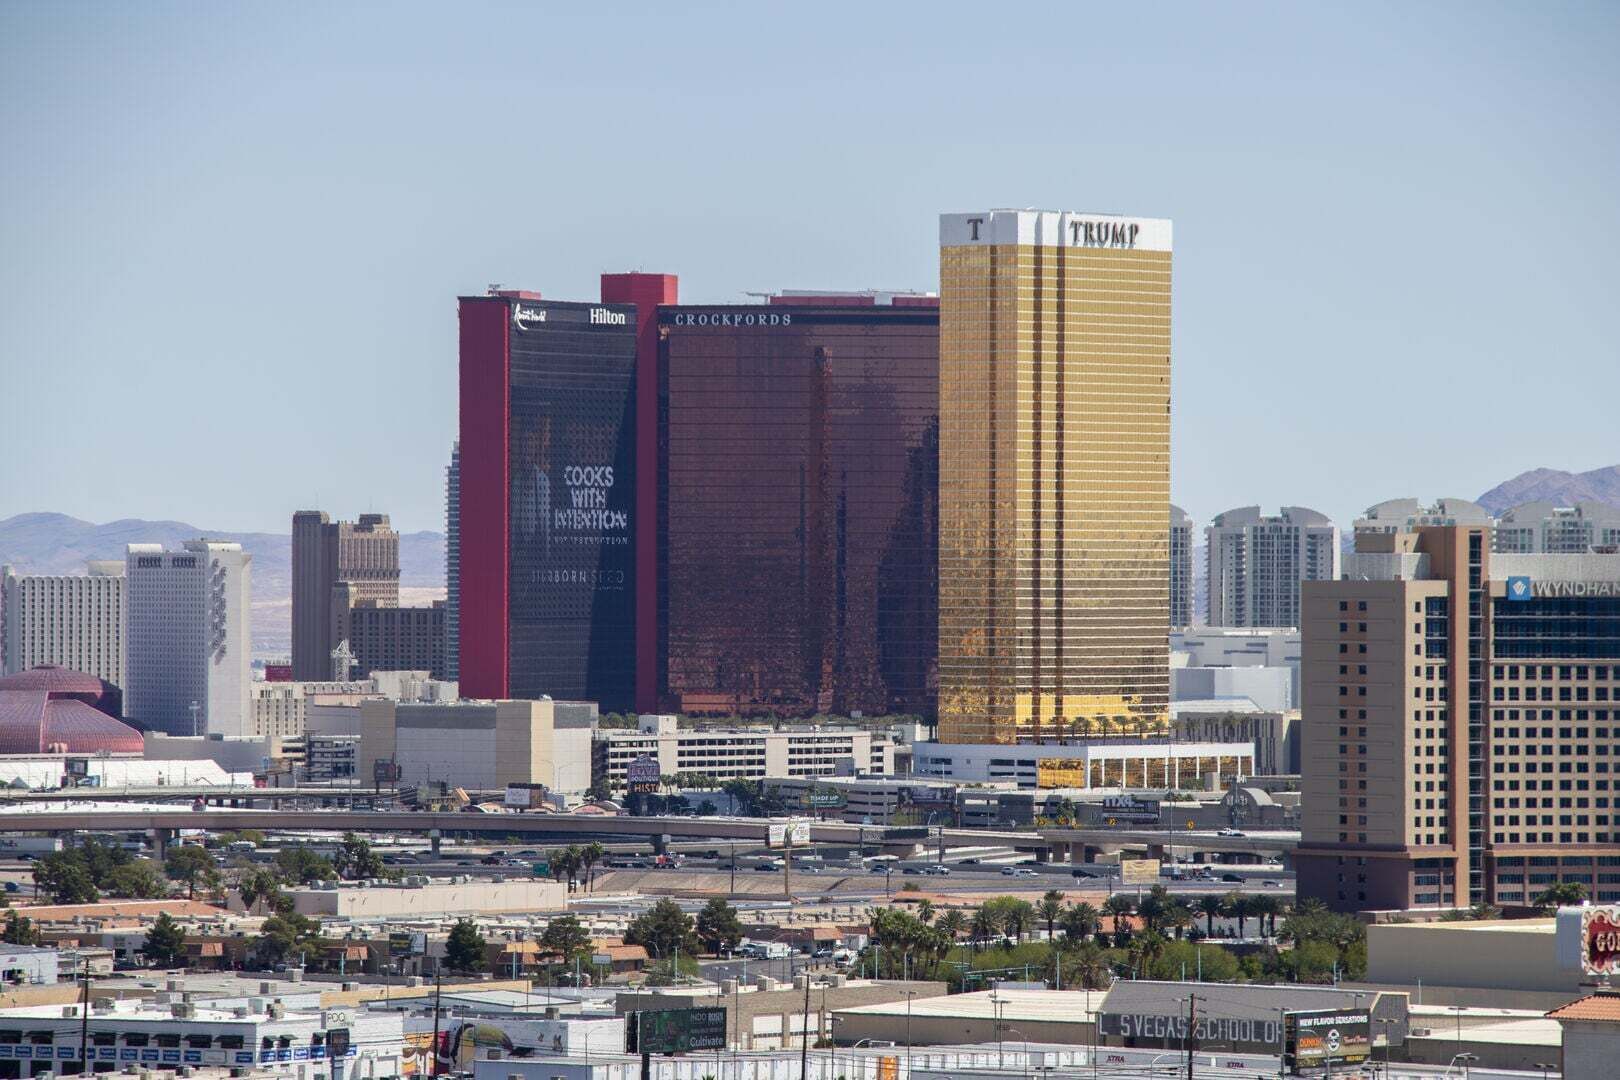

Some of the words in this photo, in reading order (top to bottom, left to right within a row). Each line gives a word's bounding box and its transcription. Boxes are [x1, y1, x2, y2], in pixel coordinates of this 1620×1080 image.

[967, 218, 983, 240] T
[1070, 220, 1139, 244] TRUMP
[590, 308, 626, 324] Hilton
[675, 313, 791, 326] CROCKFORDS
[563, 465, 614, 487] COOKS
[571, 488, 606, 508] WITH
[554, 509, 627, 529] INTENTION
[1134, 1015, 1187, 1039] VEGAS
[1196, 1018, 1261, 1042] SCHOOL
[689, 1036, 724, 1047] Cultivate
